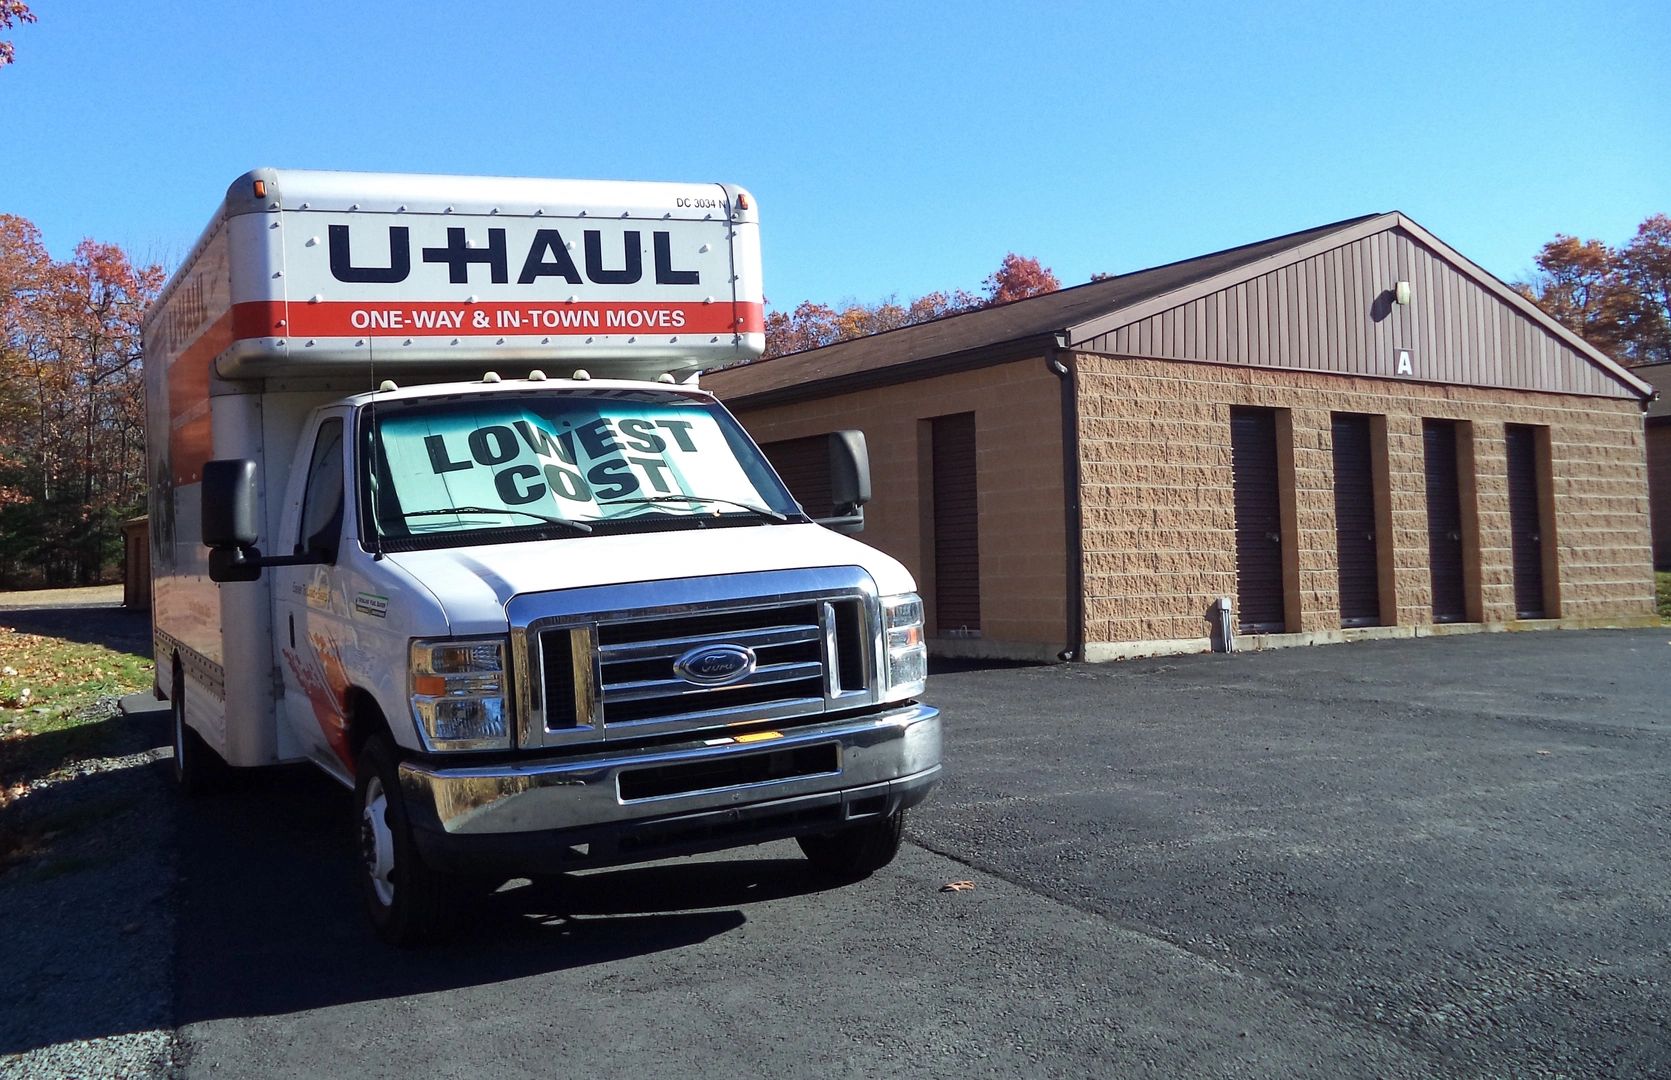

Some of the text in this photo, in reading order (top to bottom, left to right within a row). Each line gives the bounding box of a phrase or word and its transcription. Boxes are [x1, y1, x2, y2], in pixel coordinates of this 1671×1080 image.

[676, 197, 691, 208] DC
[694, 198, 716, 209] 3034
[350, 309, 686, 329] ONE-WAY & IN-TOWN MOVES
[1397, 351, 1413, 375] A
[423, 417, 699, 475] LOWEST
[494, 457, 671, 506] COST
